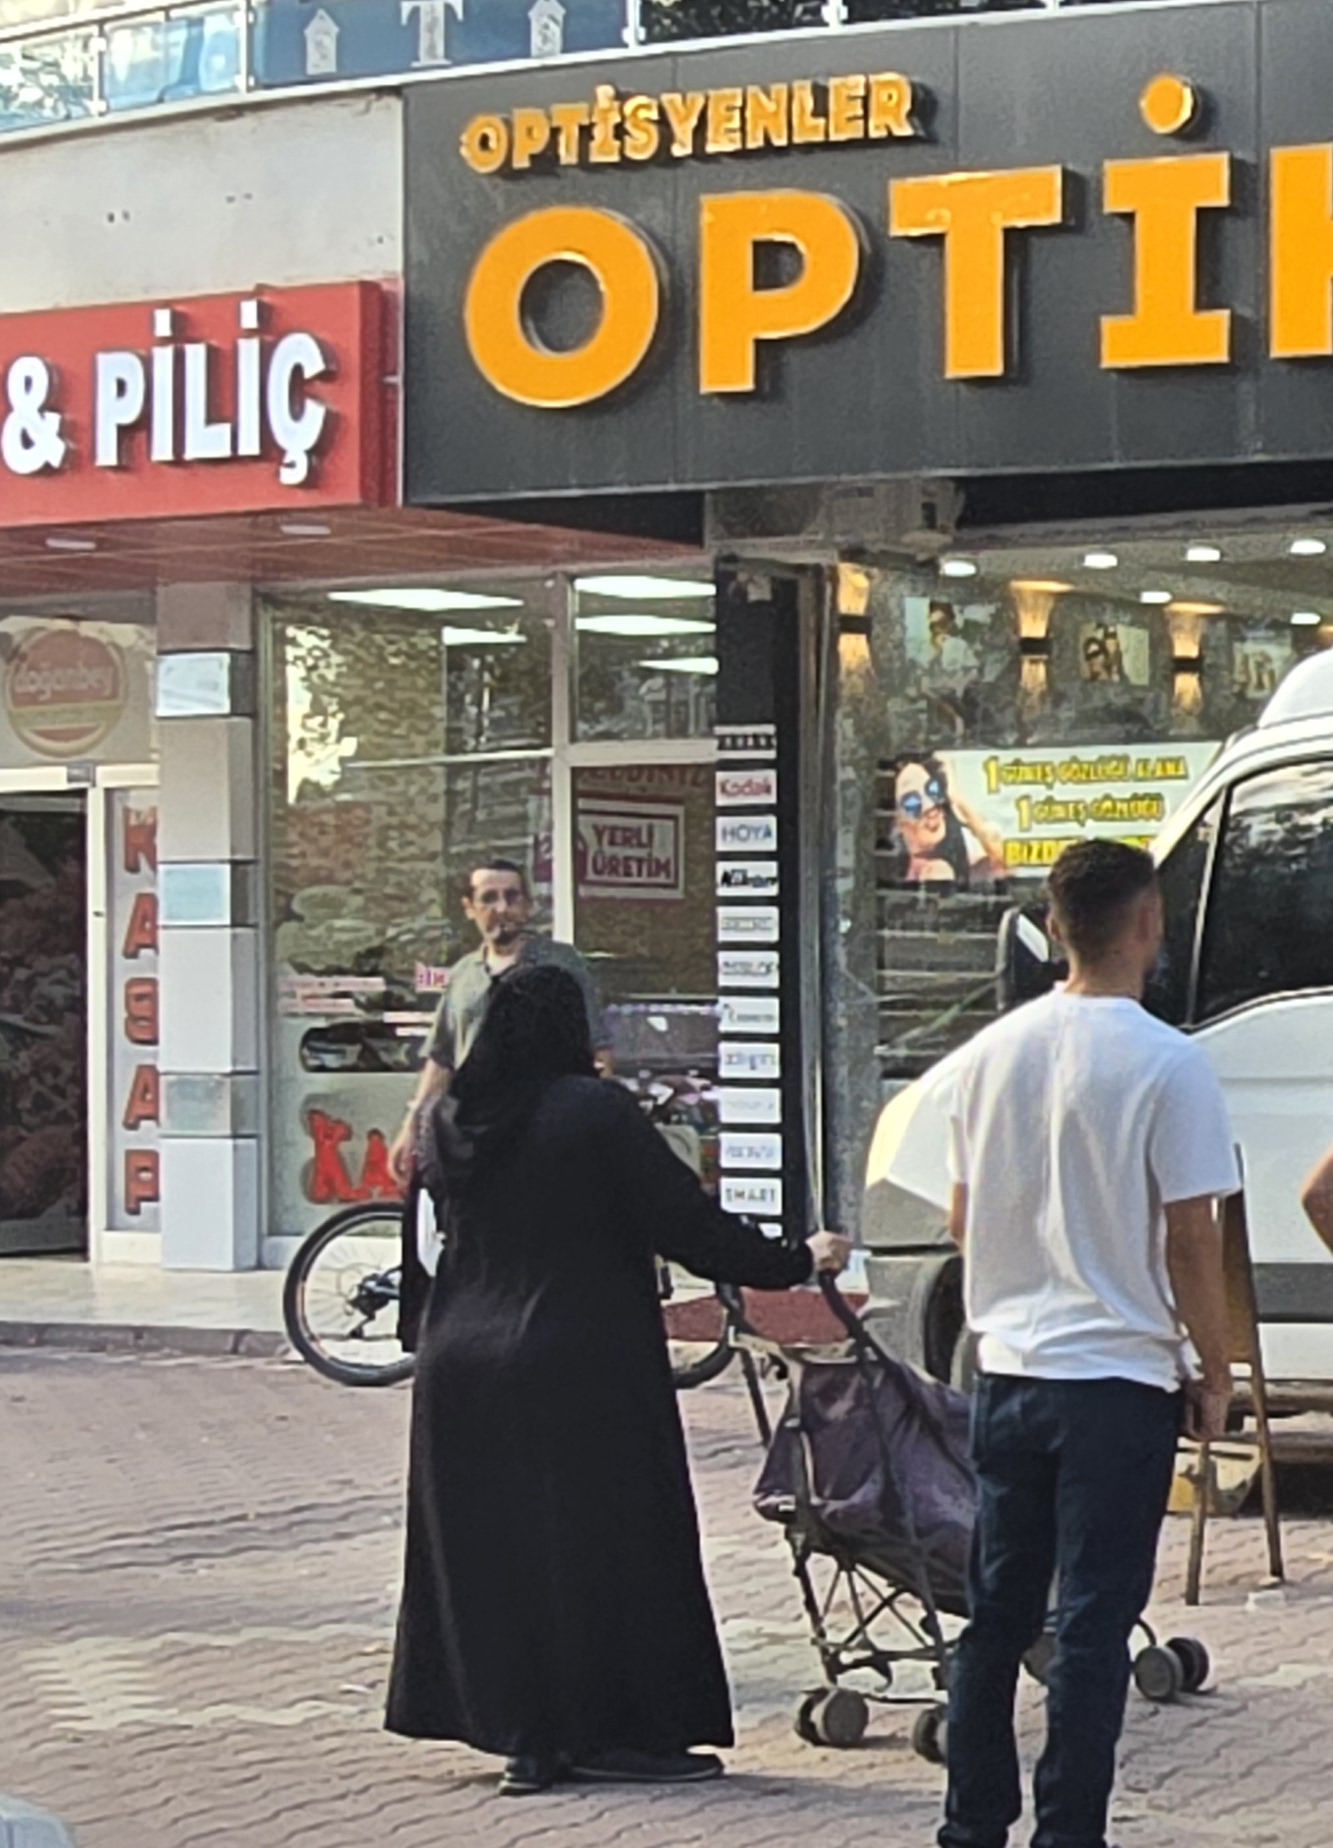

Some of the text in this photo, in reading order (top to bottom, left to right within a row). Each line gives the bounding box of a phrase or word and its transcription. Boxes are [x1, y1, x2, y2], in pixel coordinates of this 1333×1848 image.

[460, 72, 915, 174] OPTİSYENLER
[1, 299, 327, 487] & PİLİÇ
